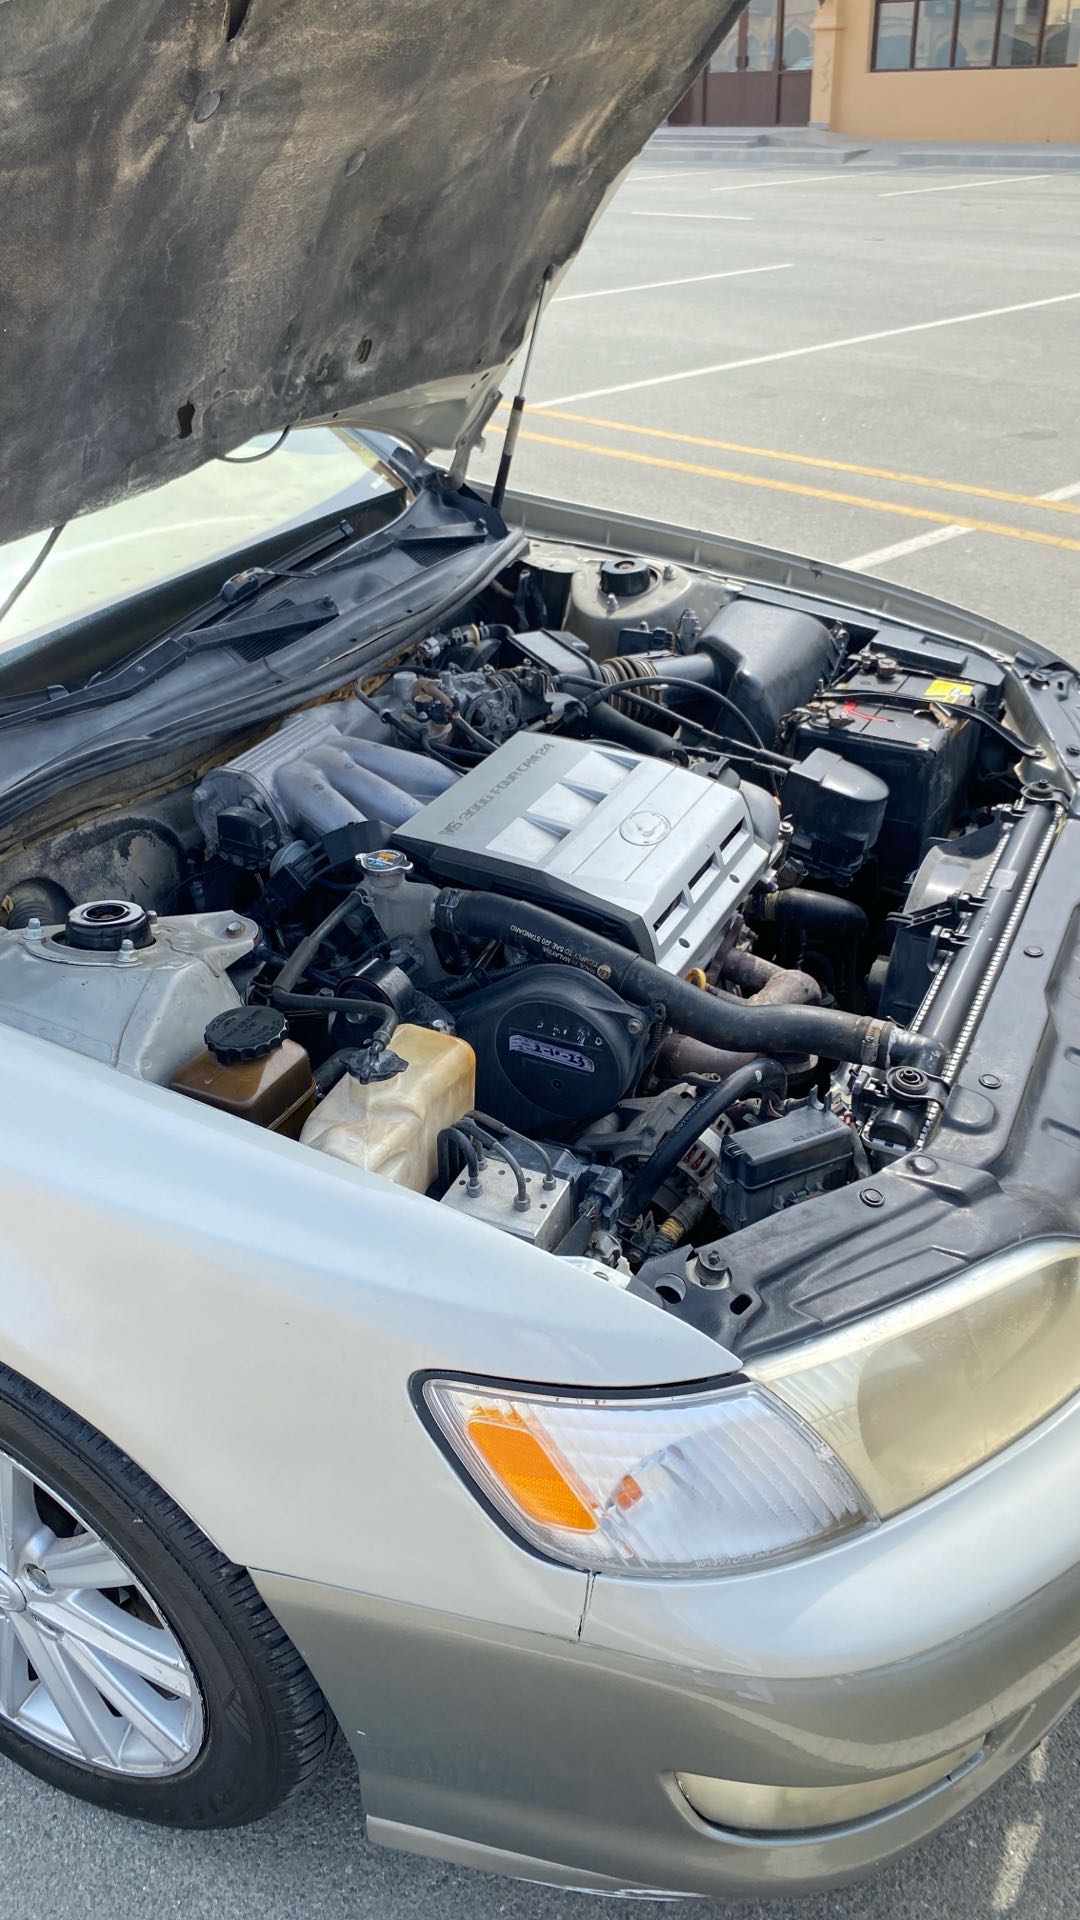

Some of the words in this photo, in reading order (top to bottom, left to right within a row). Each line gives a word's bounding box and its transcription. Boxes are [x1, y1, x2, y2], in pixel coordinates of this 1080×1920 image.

[490, 771, 520, 795] FOUR
[537, 743, 556, 759] 24
[510, 924, 541, 943] STANDARD
[542, 946, 571, 963] MALAYSIA
[552, 942, 565, 953] SAE
[564, 947, 573, 957] TO
